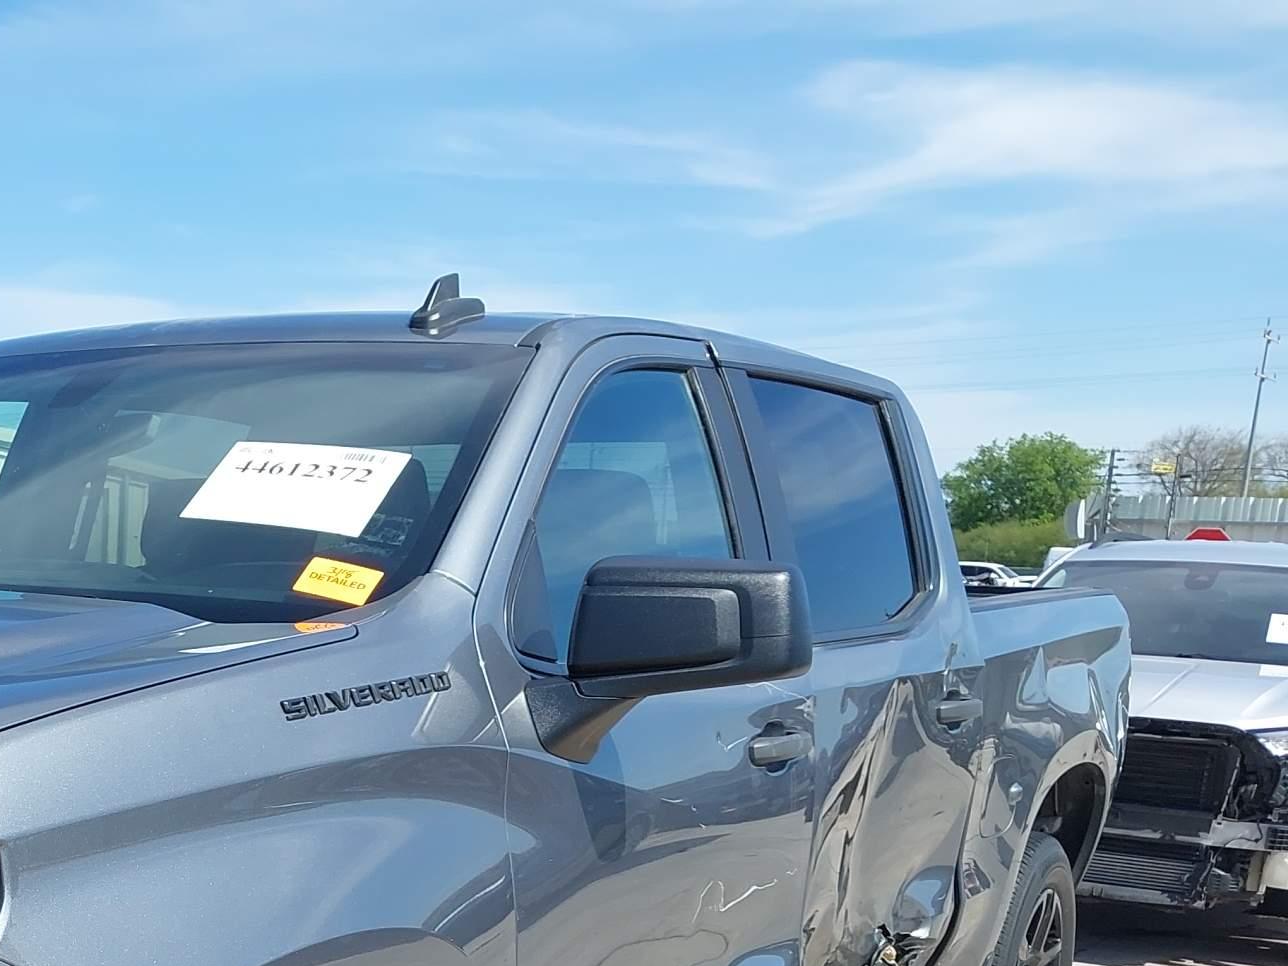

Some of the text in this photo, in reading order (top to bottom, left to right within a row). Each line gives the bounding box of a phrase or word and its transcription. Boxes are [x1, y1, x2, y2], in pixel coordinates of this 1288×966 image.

[234, 459, 374, 484] 44612372
[308, 571, 366, 590] DETAILED
[279, 671, 452, 721] SILVERADO
